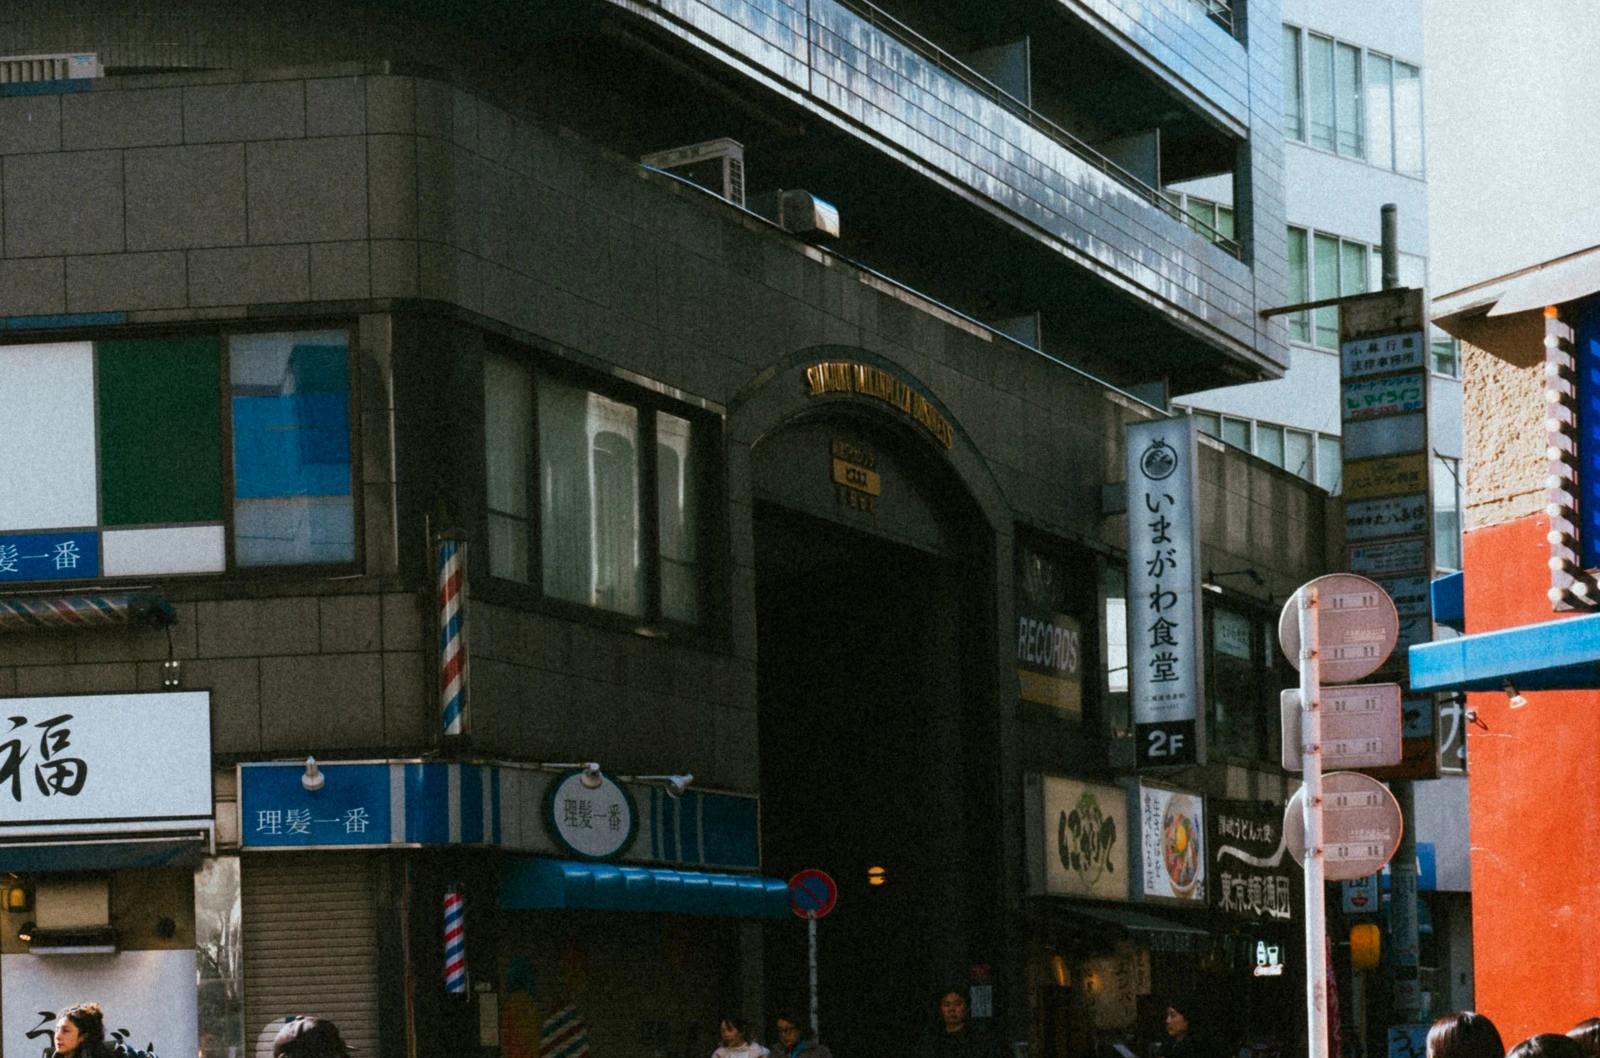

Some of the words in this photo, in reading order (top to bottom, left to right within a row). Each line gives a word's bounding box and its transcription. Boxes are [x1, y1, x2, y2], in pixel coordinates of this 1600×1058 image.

[1144, 491, 1182, 684] いまがわ食堂
[1018, 616, 1079, 674] RECORDS
[1147, 729, 1184, 757] 2F
[256, 807, 370, 836] 理髪一番
[564, 798, 622, 833] 理髪一番
[1218, 871, 1292, 920] 東京麺通団
